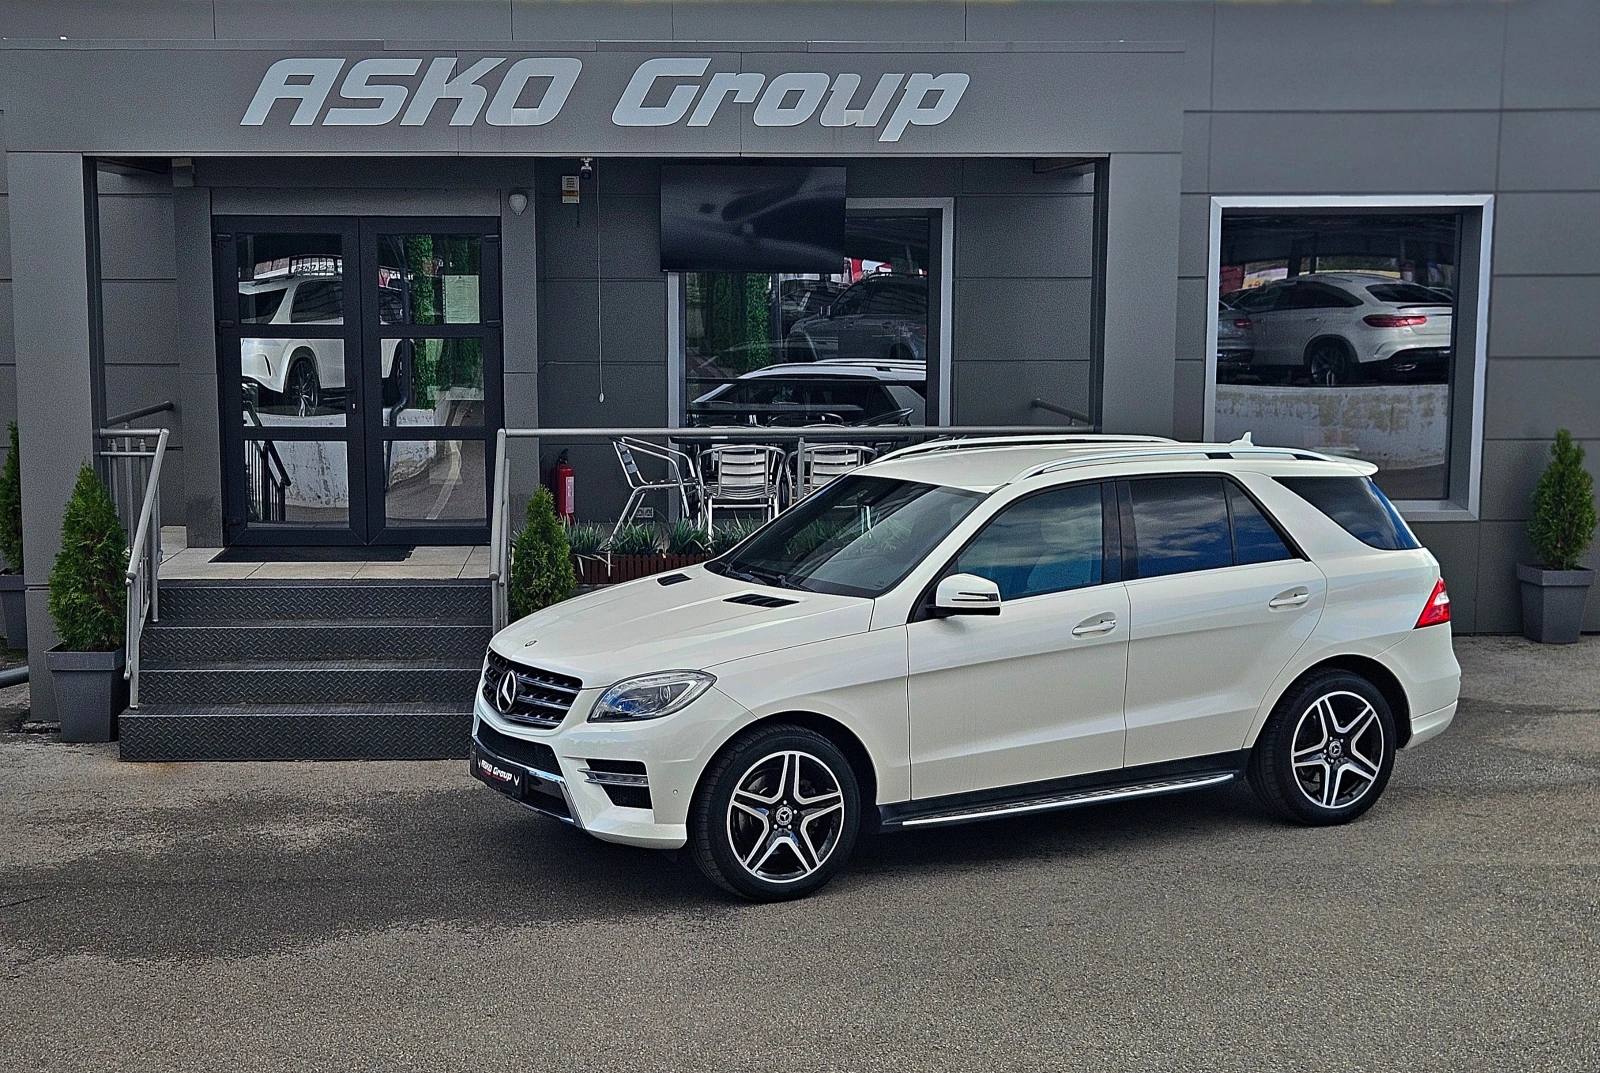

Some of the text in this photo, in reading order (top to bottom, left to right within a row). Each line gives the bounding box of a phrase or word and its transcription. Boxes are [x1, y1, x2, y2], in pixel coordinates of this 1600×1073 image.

[239, 57, 971, 142] ASKO Group
[493, 766, 513, 781] Group
